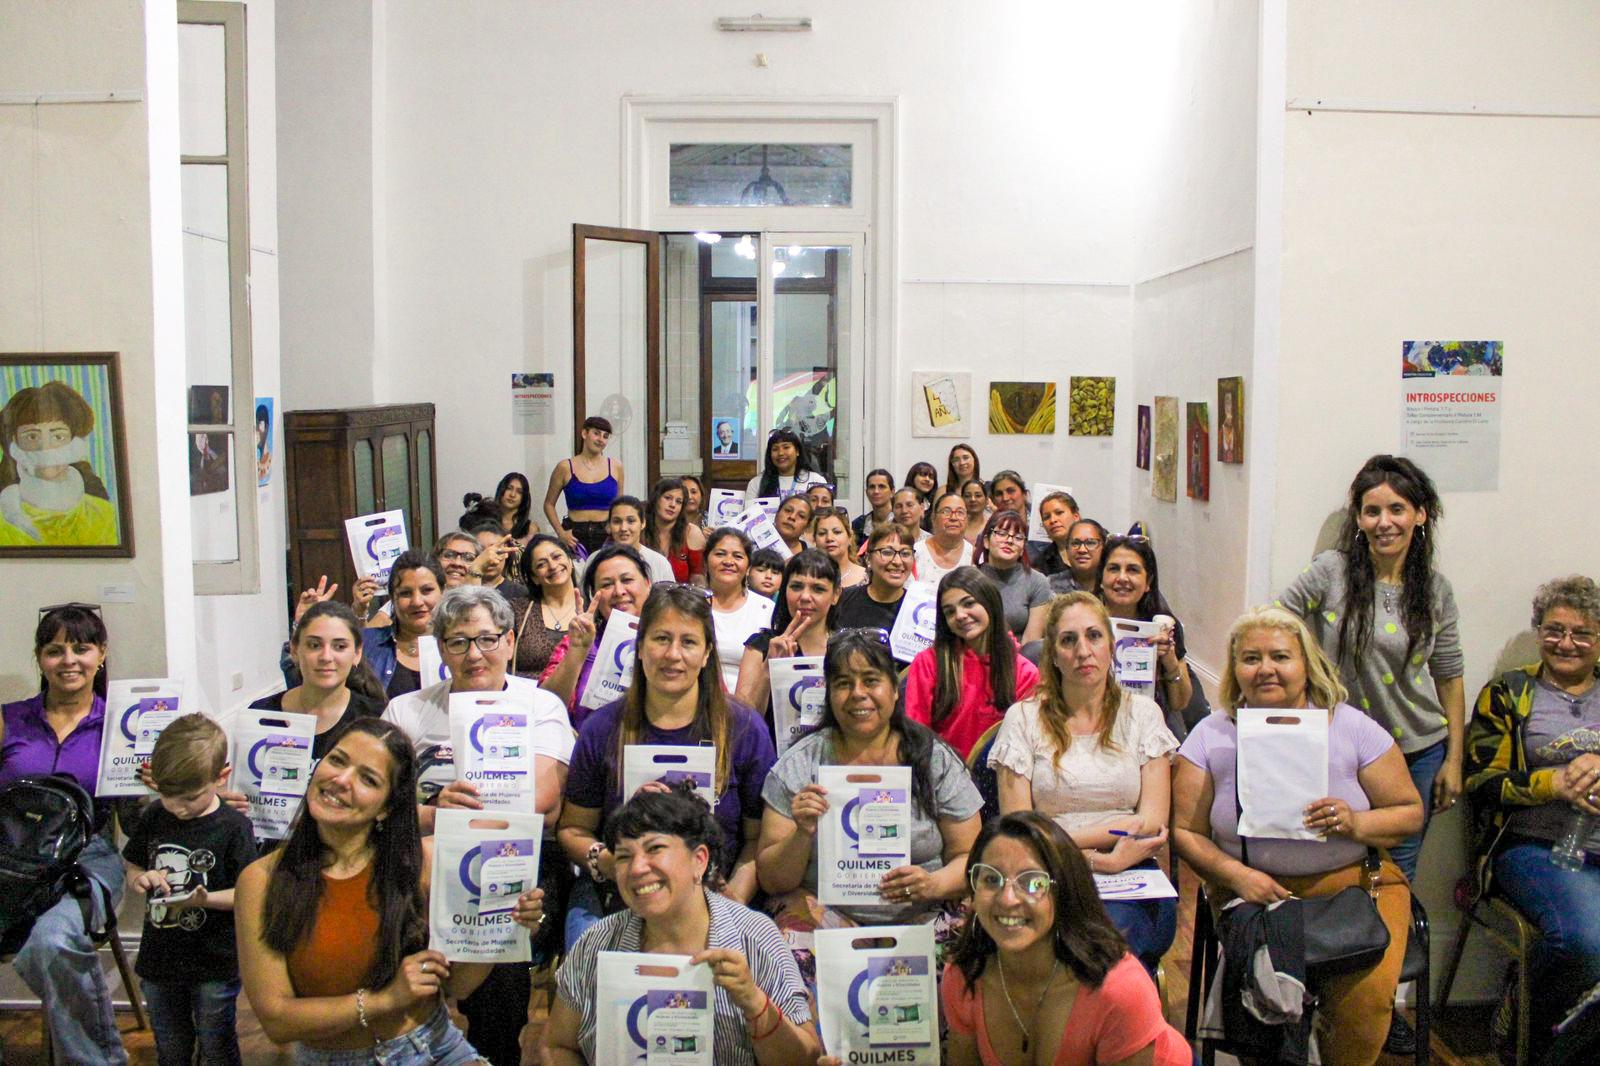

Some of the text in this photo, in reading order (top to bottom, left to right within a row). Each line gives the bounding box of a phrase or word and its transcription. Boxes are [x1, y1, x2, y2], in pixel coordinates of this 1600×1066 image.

[1406, 392, 1496, 403] INTROSPECCIONES
[112, 756, 152, 766] QUILME
[465, 771, 516, 781] QUILMES
[837, 859, 892, 871] QUILMES
[452, 913, 512, 928] QUILMES
[848, 1049, 916, 1065] QUILMES
